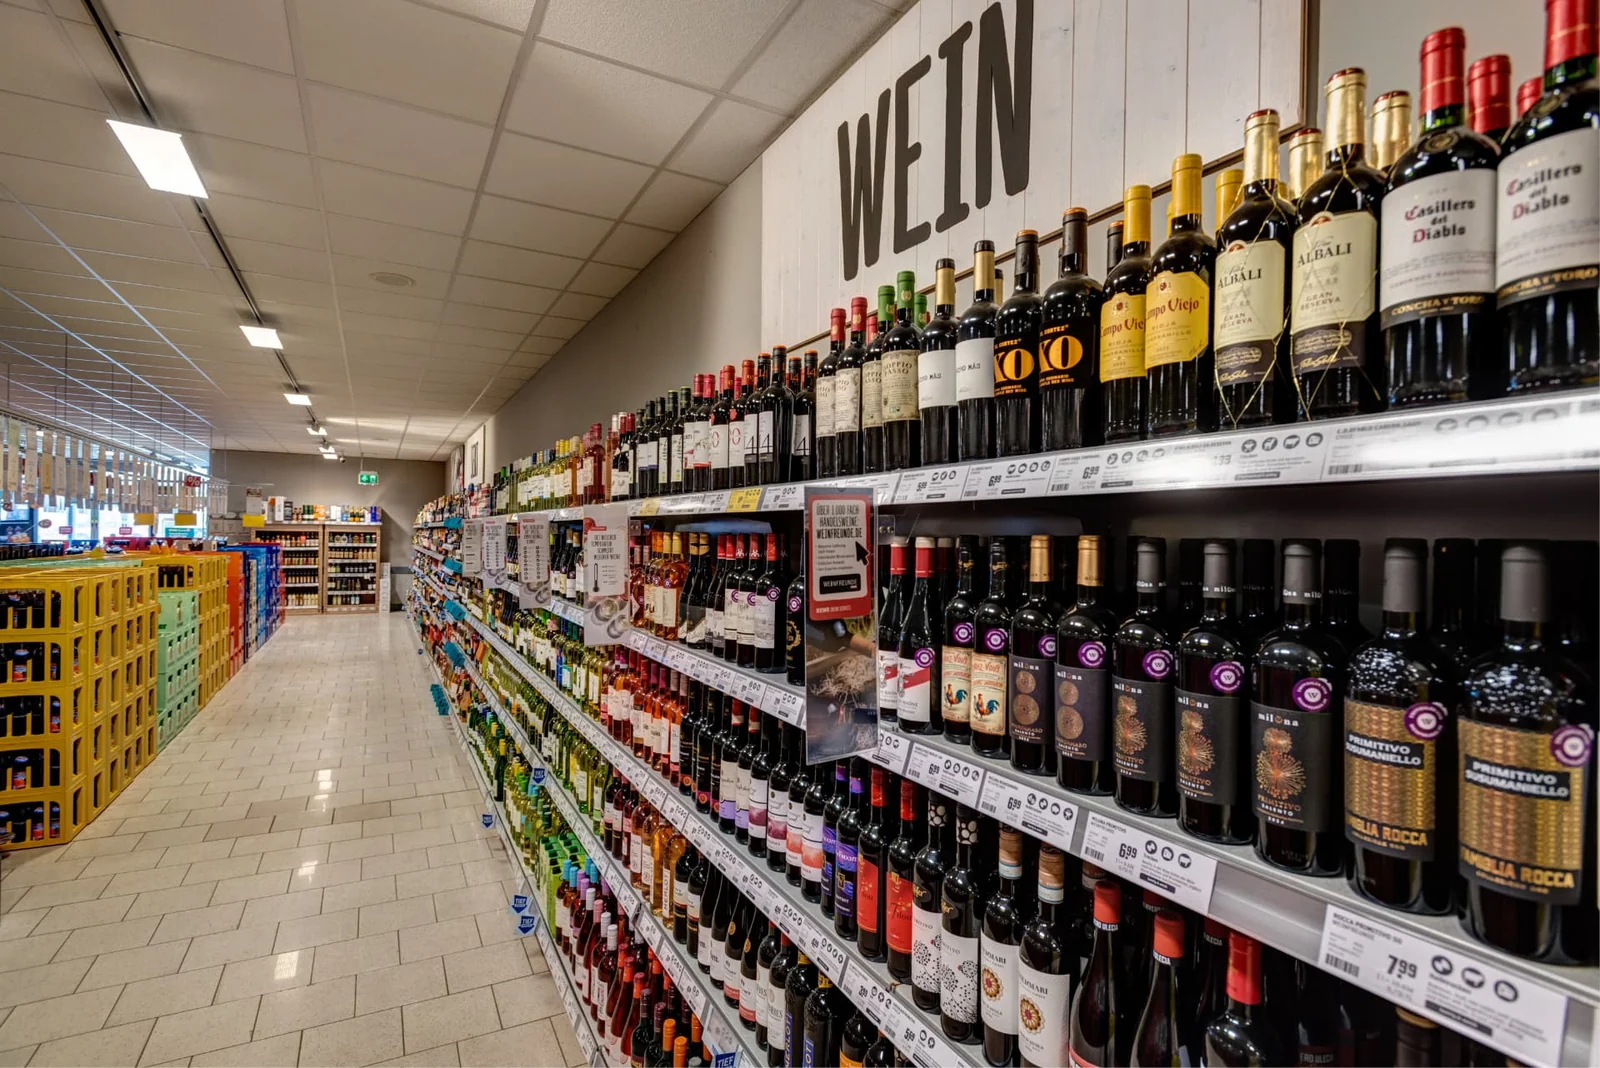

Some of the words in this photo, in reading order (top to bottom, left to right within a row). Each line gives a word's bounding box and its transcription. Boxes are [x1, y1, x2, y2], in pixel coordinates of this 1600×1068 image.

[837, 0, 1034, 281] WEIN
[1412, 224, 1466, 243] Diablo
[1297, 242, 1352, 268] ALBALI
[1217, 269, 1262, 290] ALBALI
[1168, 297, 1200, 314] Viejo
[816, 503, 830, 515] ÜBER
[831, 504, 846, 515] 1.000
[846, 503, 860, 515] FACH
[816, 528, 863, 539] WEINFREUNDE.DE
[823, 579, 858, 588] WEINFREUNDE
[1056, 670, 1083, 681] milona
[1114, 682, 1143, 695] milona
[1177, 696, 1209, 710] milona
[1258, 712, 1299, 727] milona
[1348, 734, 1411, 755] PRIMITIVO
[1472, 760, 1557, 786] PRIMITIVO
[1465, 769, 1569, 798] SUSUMANIELLO
[1007, 796, 1022, 811] 6.99
[1261, 803, 1294, 816] SALENTO
[1382, 826, 1428, 846] ROCCA
[1119, 843, 1138, 860] 6.99
[1520, 866, 1575, 889] ROCCA
[1332, 912, 1354, 925] ROCCA
[1387, 954, 1418, 979] 7.99
[717, 1055, 734, 1067] TIEF
